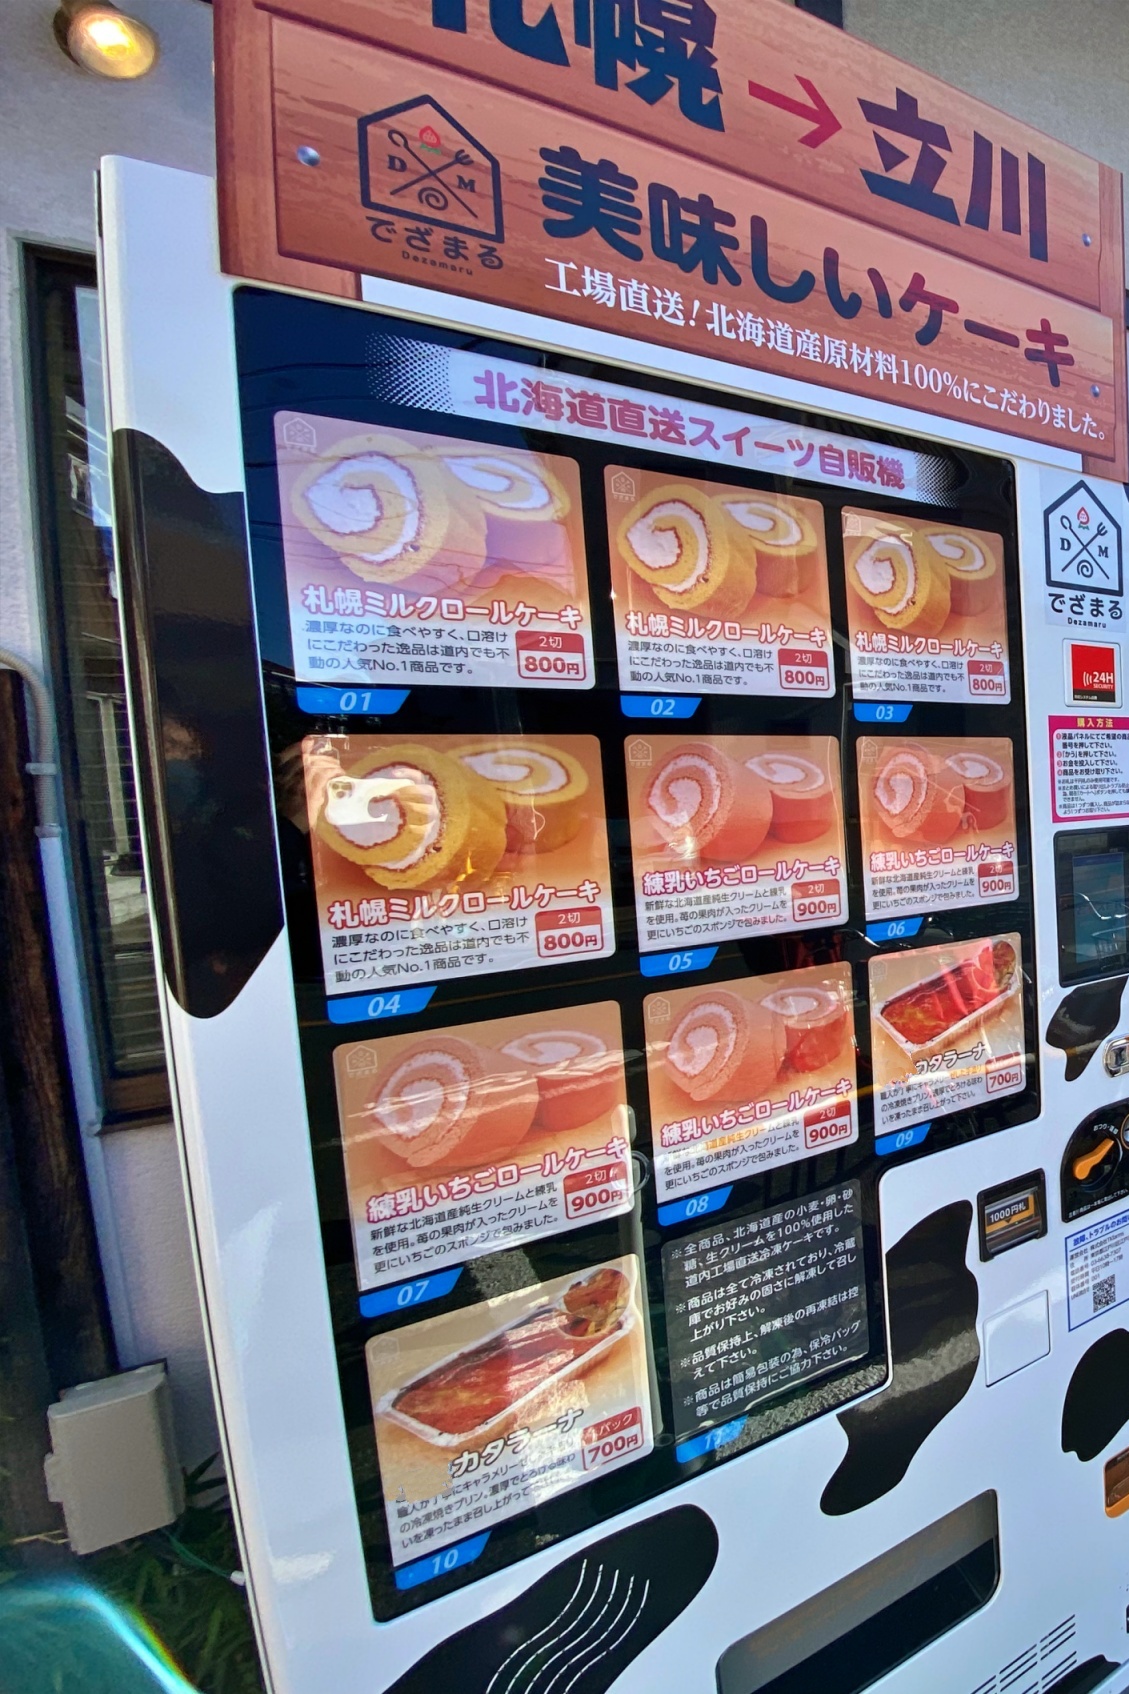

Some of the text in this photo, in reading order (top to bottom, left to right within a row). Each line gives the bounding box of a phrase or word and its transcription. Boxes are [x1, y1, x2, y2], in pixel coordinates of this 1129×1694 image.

[387, 154, 407, 172] D
[457, 175, 476, 193] M
[857, 87, 1049, 263] 立川
[366, 216, 504, 270] でざまる
[401, 250, 474, 276] Dezamaru
[538, 145, 1076, 388] 美味しいケーキ
[473, 369, 906, 490] 北海道直送スイーツ自販機
[1060, 537, 1071, 551] D
[1098, 545, 1109, 558] M
[302, 585, 583, 630] 札幌ミルクロールケーキ
[1048, 593, 1123, 620] でざまる
[305, 620, 508, 643] 濃厚なのに食べやすく、口溶け
[625, 610, 828, 648] 札幌ミルクロールケーキ
[1067, 617, 1107, 629] Dezamaru
[307, 638, 509, 659] にこだわった逸品は道内でも不
[539, 636, 562, 649] 2切
[628, 640, 773, 659] 濃厚なのに食べやすく、口溶け
[855, 631, 1004, 660] 札幌ミルクロールケーキ
[308, 656, 474, 675] 動の人気No.1商品です。
[524, 656, 580, 675] 800円
[629, 656, 774, 673] にこだわった逸品は道内でも不
[795, 653, 812, 664] 2切
[980, 664, 993, 673] 2切
[630, 671, 749, 686] 動の人気No.1商品です。
[784, 671, 825, 686] 800円
[972, 678, 1003, 692] 800円
[1092, 671, 1114, 683] 24H
[339, 691, 372, 711] 01
[650, 698, 676, 716] 02
[875, 705, 894, 720] 03
[1077, 718, 1114, 728] 購入方法
[870, 841, 1015, 874] 練乳いちごロールケーキ
[642, 855, 842, 898] 練乳いちごロールケーキ
[981, 879, 1012, 893] 900円
[807, 884, 825, 895] 2切
[328, 879, 602, 931] 札幌ミルクロールケーキ
[797, 899, 837, 917] 900円
[558, 912, 581, 925] 2切
[331, 916, 529, 949] 濃厚なのに食べやすく、口溶け
[887, 921, 906, 938] 06
[333, 932, 530, 966] にこだわった逸品は道内でも不
[543, 931, 598, 951] 800円
[335, 955, 496, 984] 動の人気No.1商品です。
[668, 952, 694, 972] 05
[367, 994, 402, 1018] 04
[989, 1071, 1019, 1088] 700円
[661, 1078, 852, 1149] 練乳いちごロールケーキ
[809, 1124, 848, 1143] 900円
[895, 1130, 914, 1148] 09
[366, 1136, 629, 1224] 練乳いちごロールケーキ
[585, 1171, 606, 1186] 2切
[571, 1188, 623, 1212] 900円
[685, 1196, 709, 1217] 08
[990, 1201, 1027, 1223] 1000円札
[685, 1226, 840, 1289] 道内工場直送冷凍ケーキです。
[396, 1280, 430, 1307] 07
[690, 1307, 767, 1343] 上がり下さい。
[693, 1348, 758, 1380] えて下さい。
[451, 1407, 585, 1479] カタラーナ
[587, 1433, 639, 1463] 700円
[431, 1549, 459, 1575] 10
